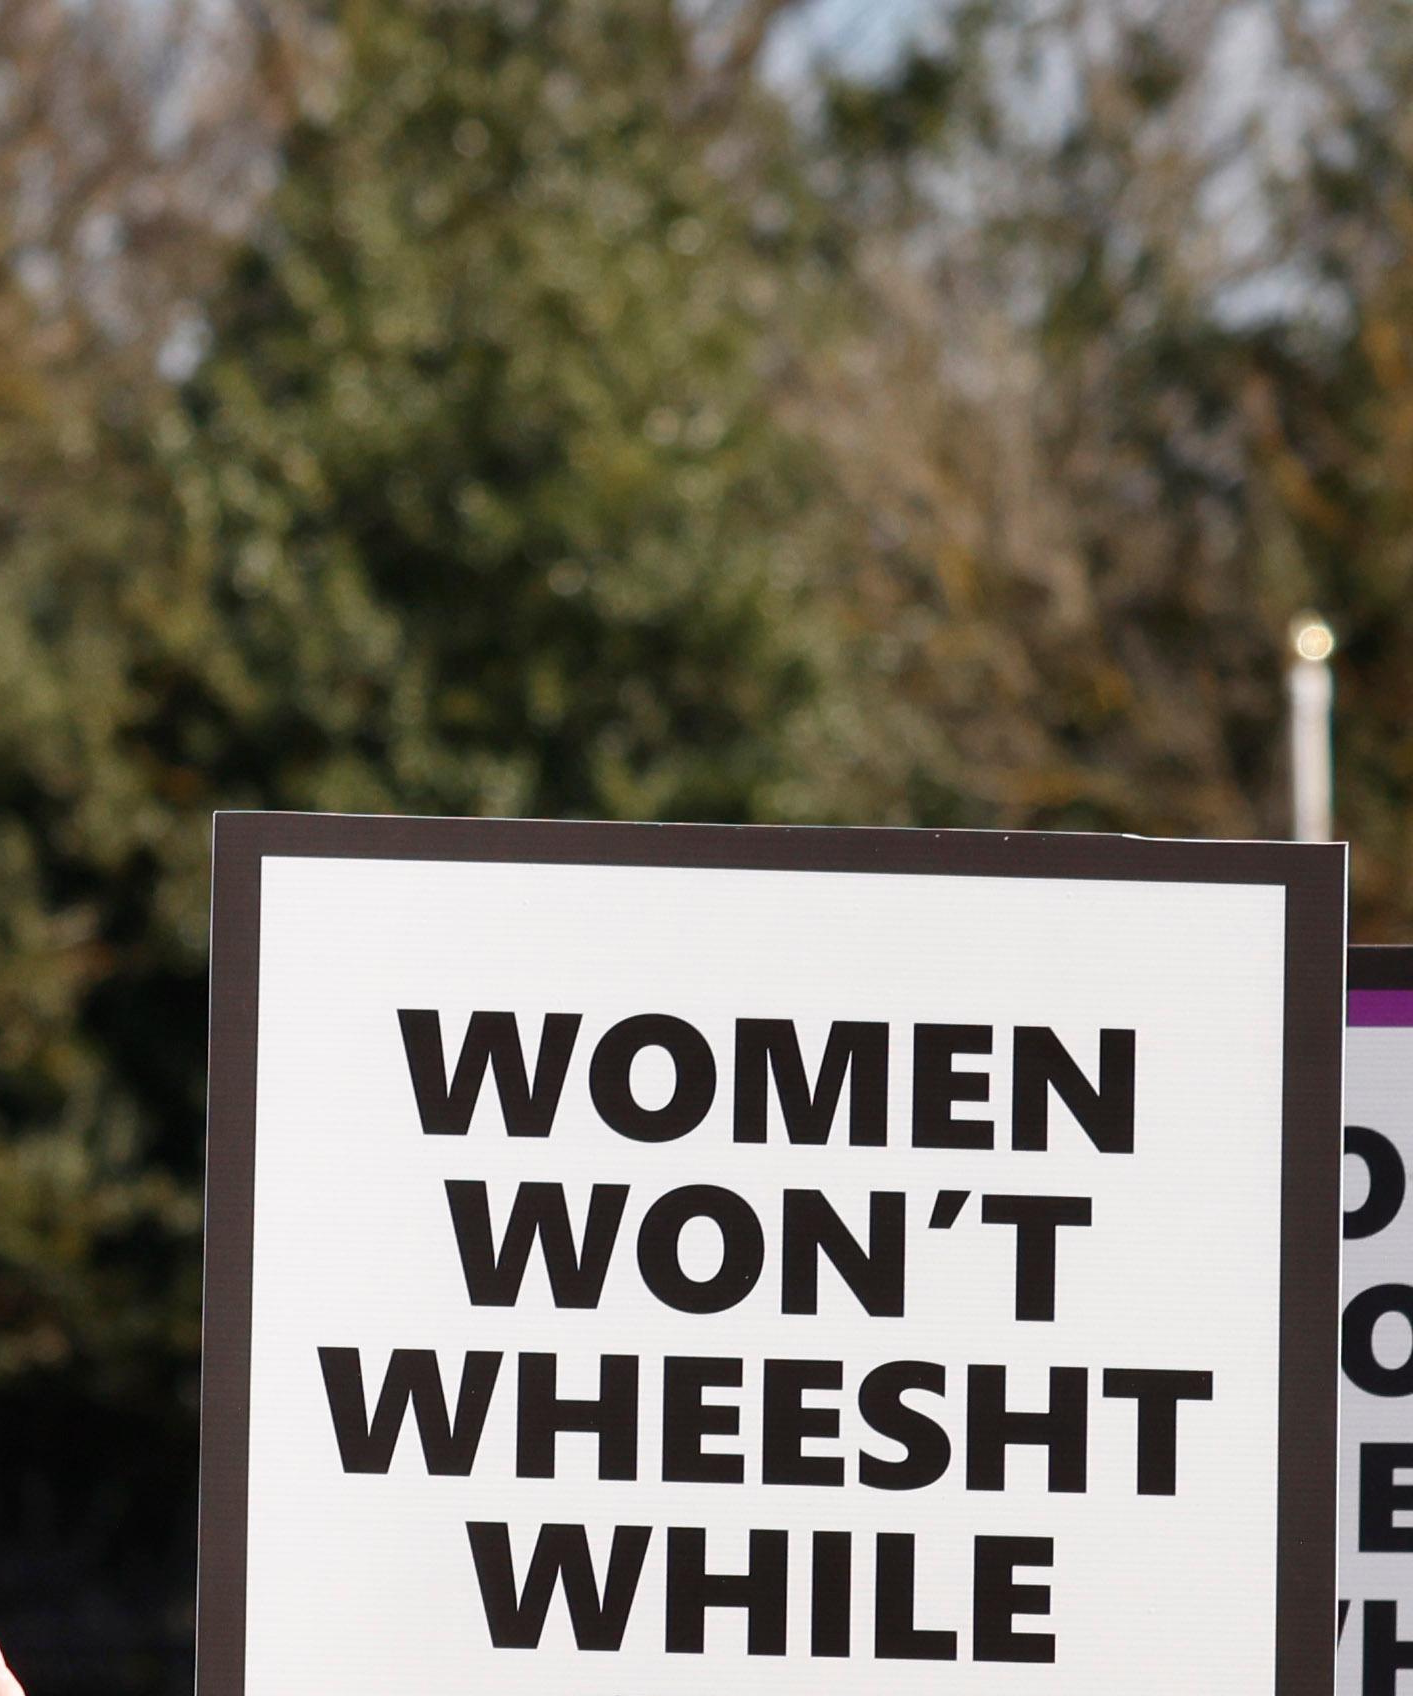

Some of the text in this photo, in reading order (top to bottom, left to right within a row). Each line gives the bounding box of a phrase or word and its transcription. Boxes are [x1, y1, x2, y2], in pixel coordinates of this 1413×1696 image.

[398, 1010, 1135, 1153] WOMEN
[445, 1180, 1091, 1321] WON'T
[318, 1347, 1212, 1495] WHEESHT
[467, 1522, 1055, 1663] WHILE
